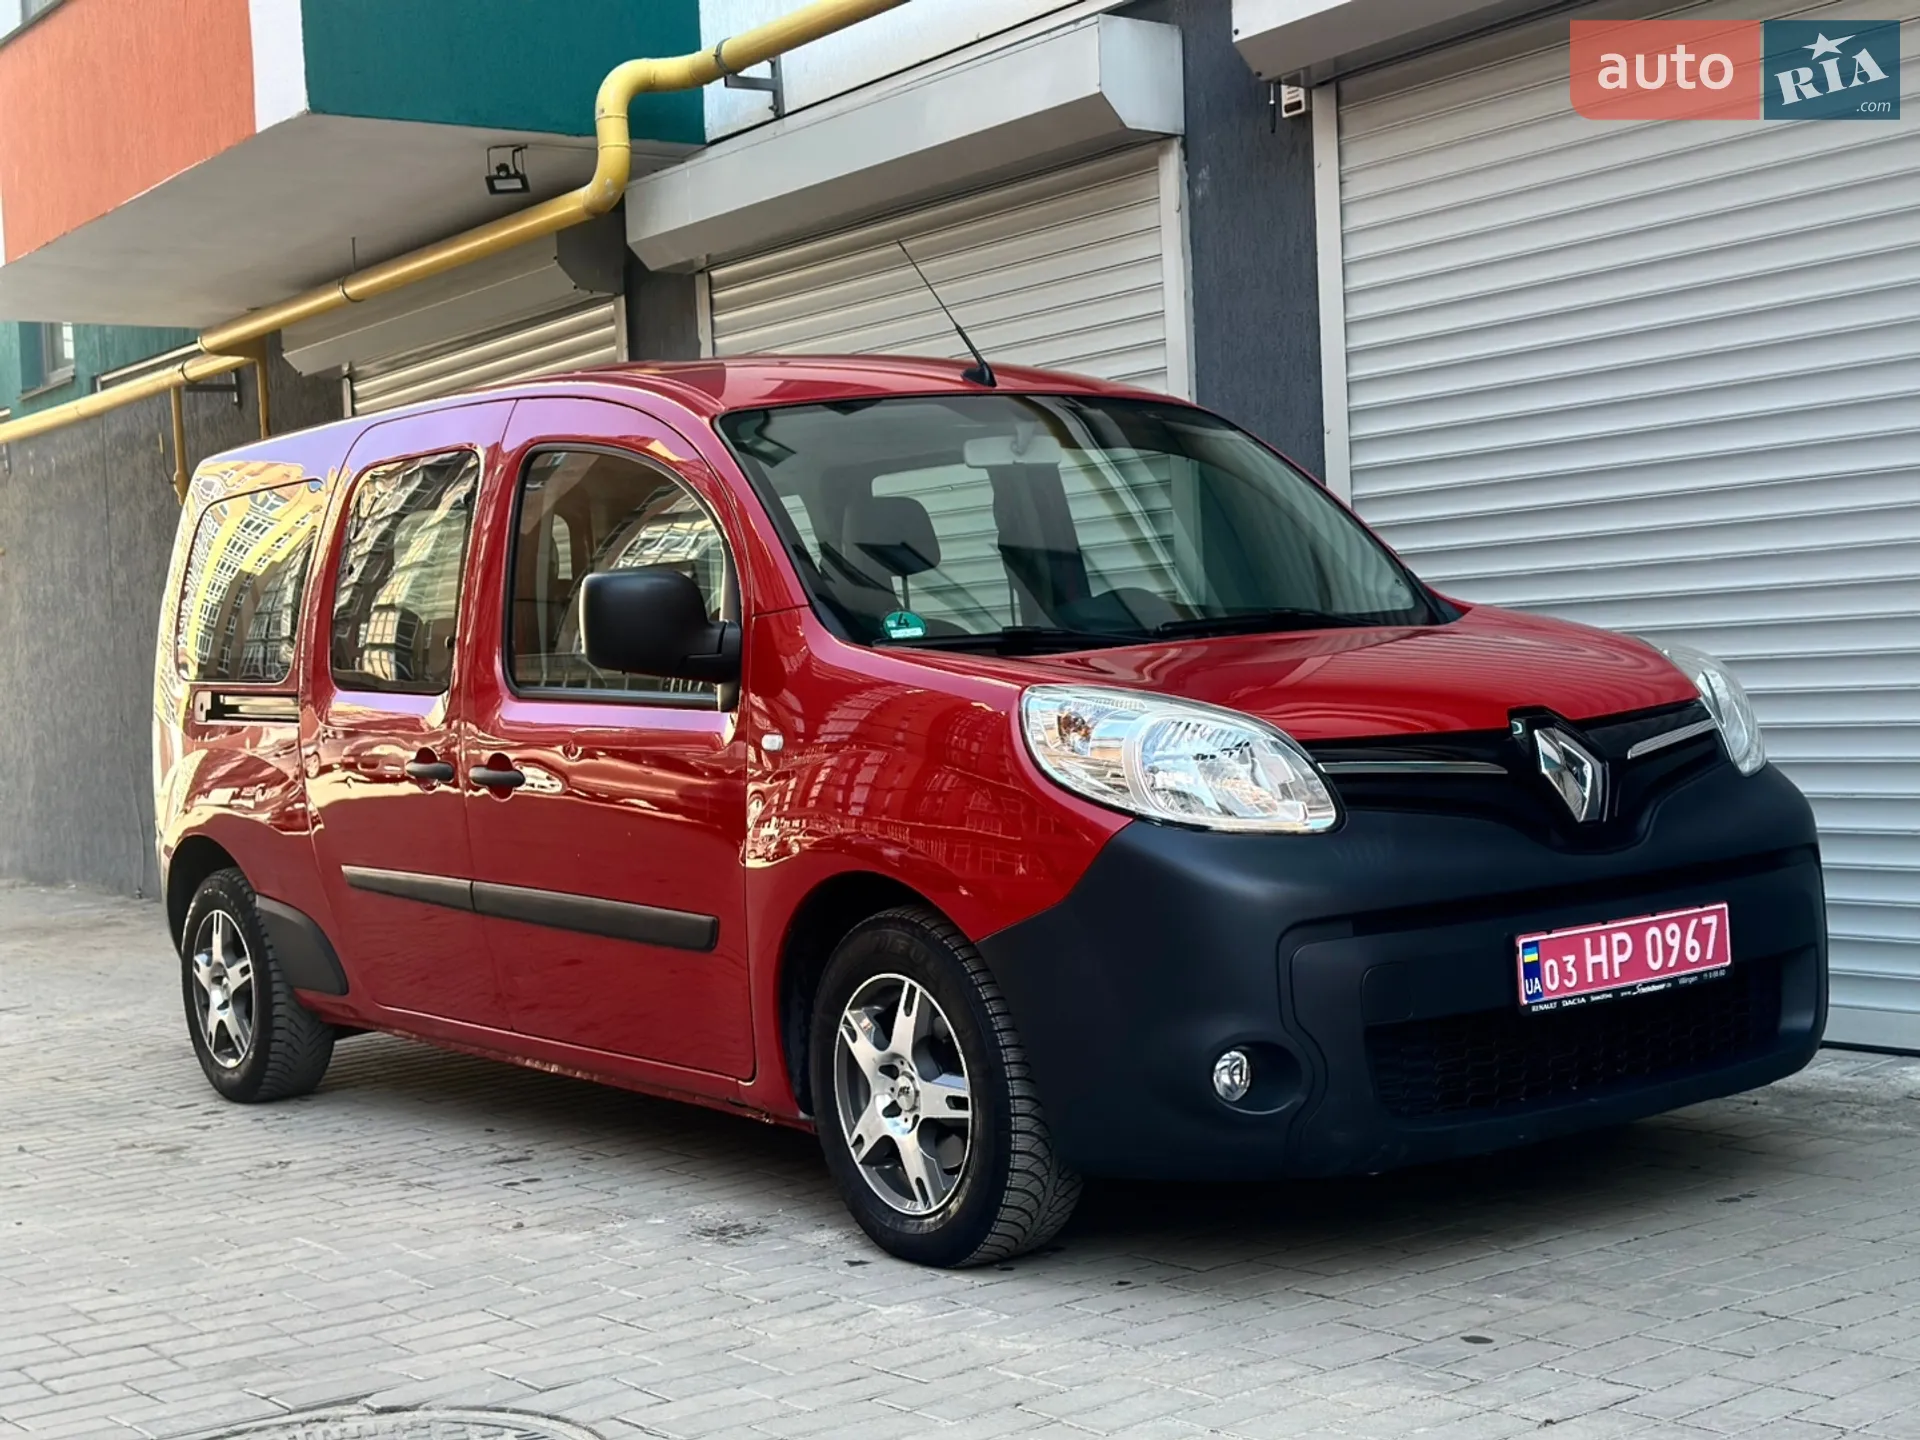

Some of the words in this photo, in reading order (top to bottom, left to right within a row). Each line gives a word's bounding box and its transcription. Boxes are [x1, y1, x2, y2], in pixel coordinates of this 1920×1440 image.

[1544, 955, 1578, 992] 03
[1584, 932, 1634, 983] HP
[1645, 915, 1718, 971] 0967
[1525, 977, 1543, 995] UA
[1562, 997, 1587, 1007] DACIA
